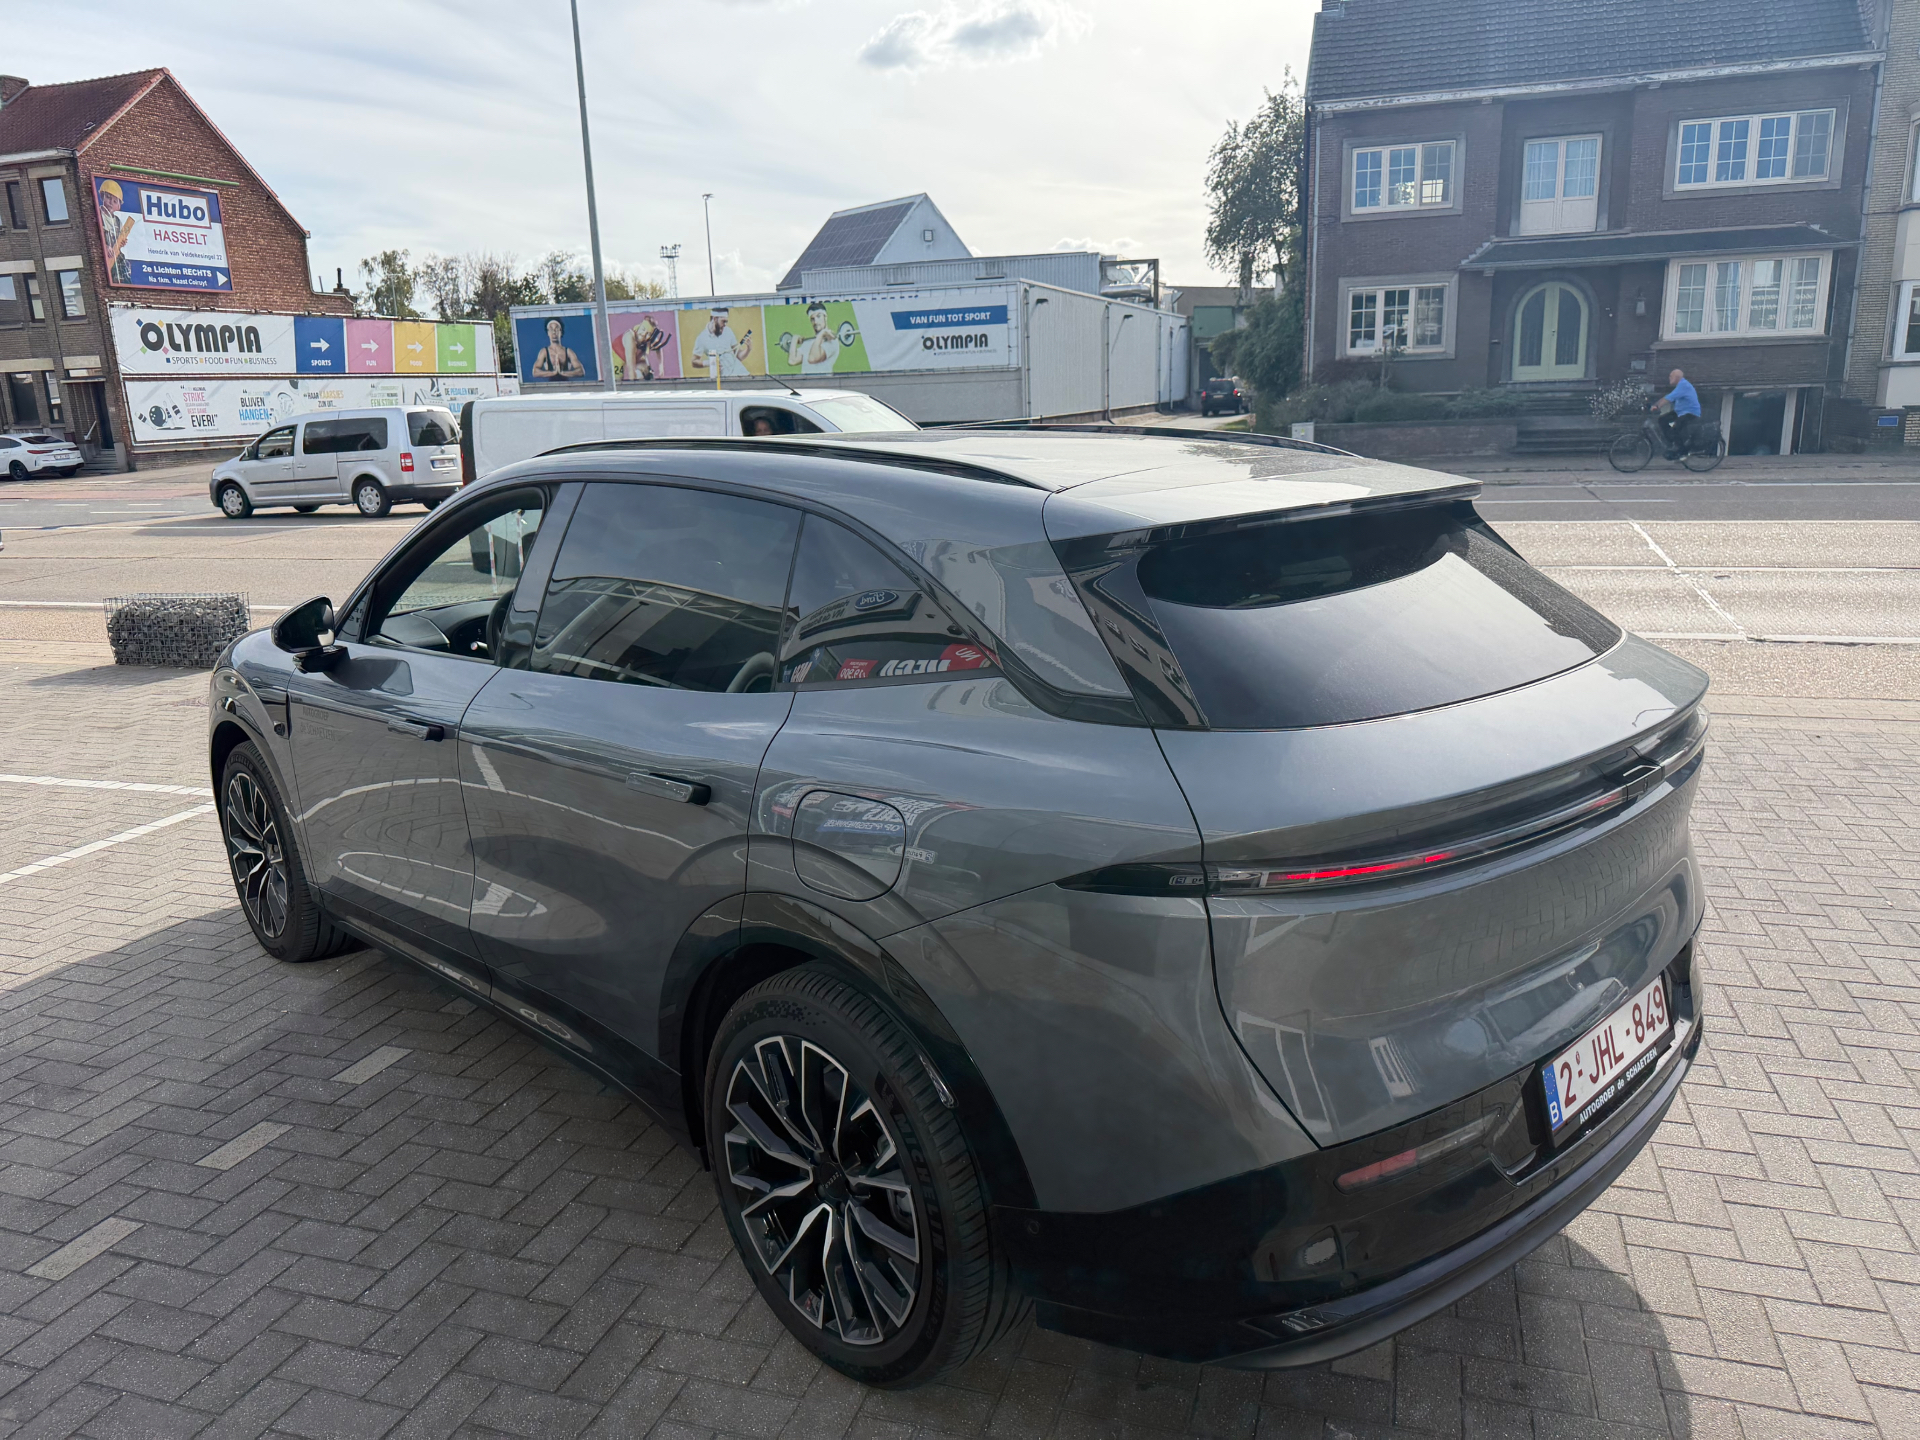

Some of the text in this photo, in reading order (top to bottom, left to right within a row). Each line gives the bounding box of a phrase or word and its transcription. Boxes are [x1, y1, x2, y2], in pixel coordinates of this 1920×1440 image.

[146, 194, 206, 221] Hubo
[153, 228, 208, 246] HASSELT
[147, 248, 169, 257] Hendrik
[142, 264, 212, 278] 2e Lichten RECHTS
[910, 312, 992, 324] VAN FUN TOT SPORT
[140, 322, 263, 354] OLYMPIA
[922, 333, 989, 350] OLYMPIA
[172, 356, 277, 365] SPORTS FOOD FUN BUSINESS
[182, 392, 206, 402] STRIKE
[1579, 1047, 1658, 1125] AUTOGROEP de SCHAETZEN
[1550, 1101, 1560, 1124] B
[893, 1112, 946, 1254] MICHELIN
